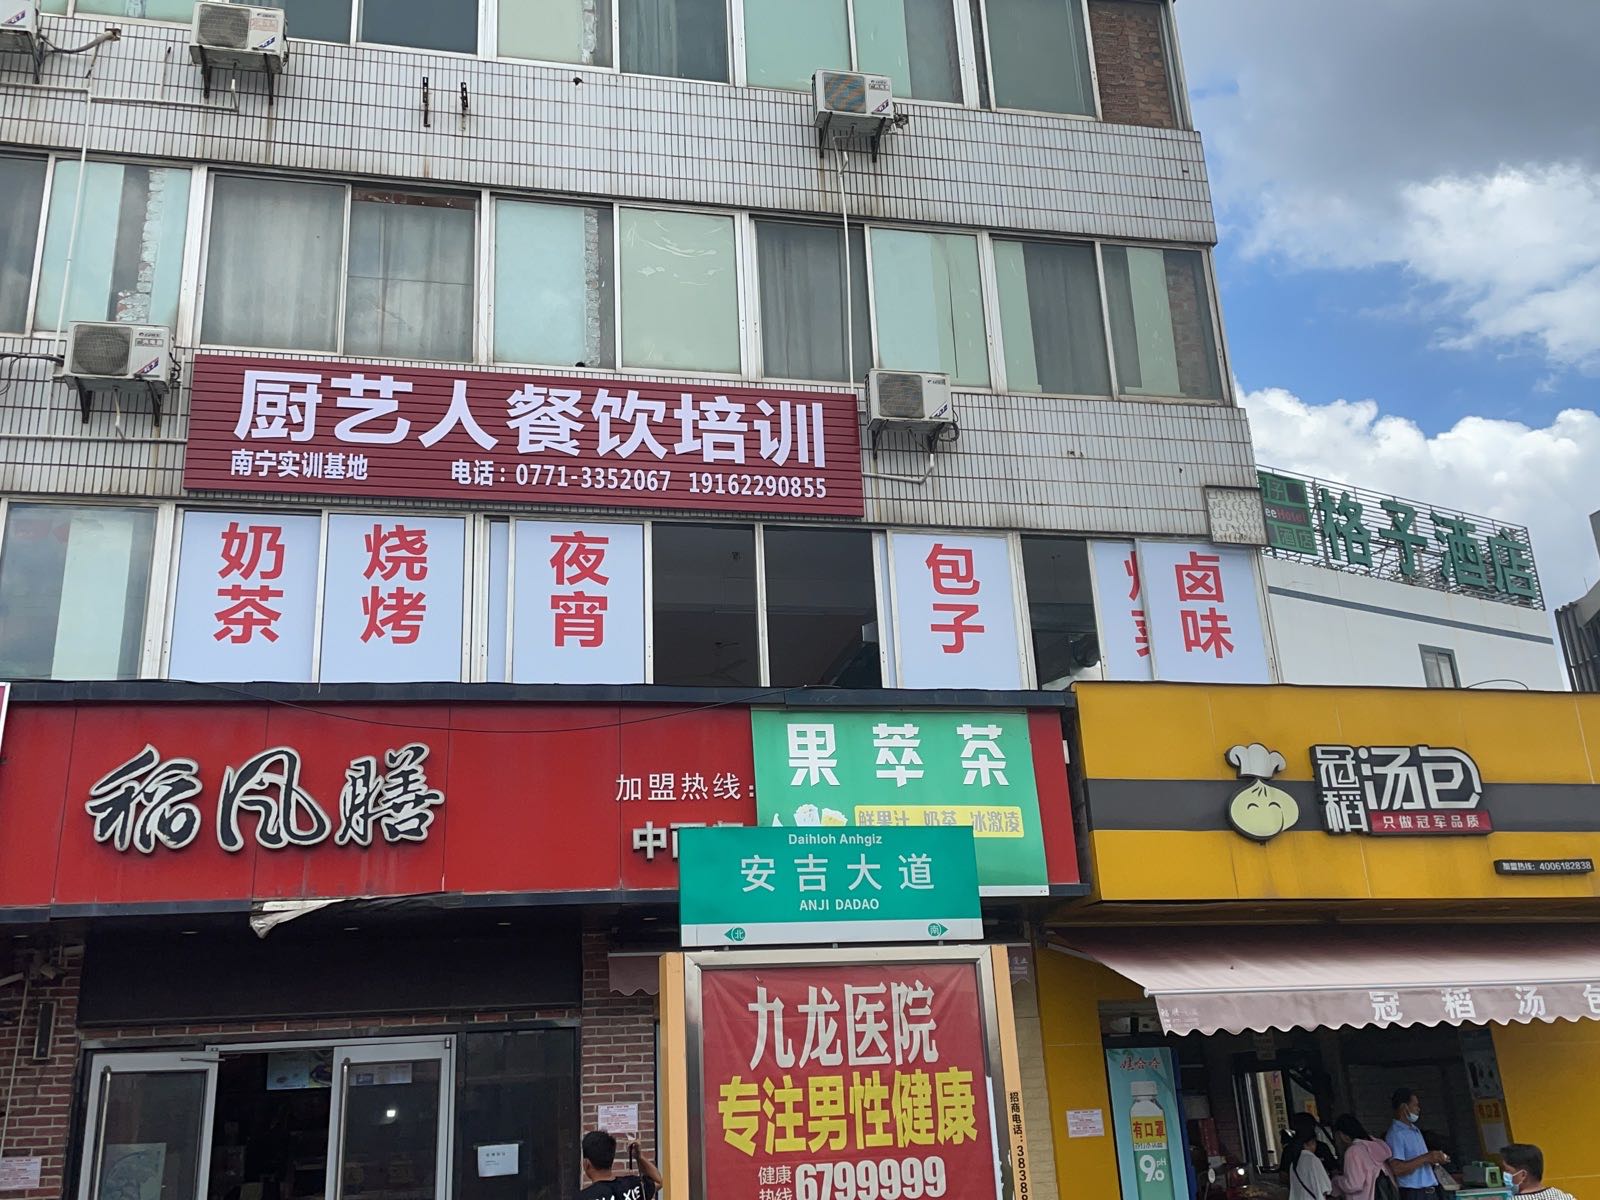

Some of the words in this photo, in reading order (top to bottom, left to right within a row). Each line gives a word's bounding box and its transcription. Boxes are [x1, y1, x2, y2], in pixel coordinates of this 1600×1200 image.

[233, 369, 826, 468] 厨艺人餐饮培训
[230, 449, 369, 481] 南宁实训基地
[689, 472, 826, 499] 19162290855
[1319, 487, 1538, 599] 格子酒店
[212, 521, 286, 645] 奶茶
[360, 523, 429, 645] 烧烤
[549, 530, 610, 648] 夜宵
[925, 543, 985, 654] 包子
[1174, 551, 1235, 659] 卤味
[787, 723, 1010, 787] 果萃茶
[1359, 746, 1483, 811] 汤包
[615, 772, 755, 801] 加盟热线：
[1314, 745, 1370, 833] 冠稻
[788, 833, 837, 846] Daihloh
[839, 833, 883, 847] Anhgiz
[969, 810, 1021, 833] 冰激凌
[1382, 814, 1481, 830] 只做冠军品质
[740, 852, 935, 893] 安吉大道
[1539, 861, 1592, 871] 4006182838
[799, 899, 830, 911] ANJI
[835, 898, 880, 911] DADAO
[748, 979, 939, 1071] 九龙医院
[718, 1066, 978, 1157] 专注男性健康
[1132, 1120, 1166, 1139] 有口罩
[758, 1165, 792, 1186] 健康
[795, 1155, 946, 1200] 6799999
